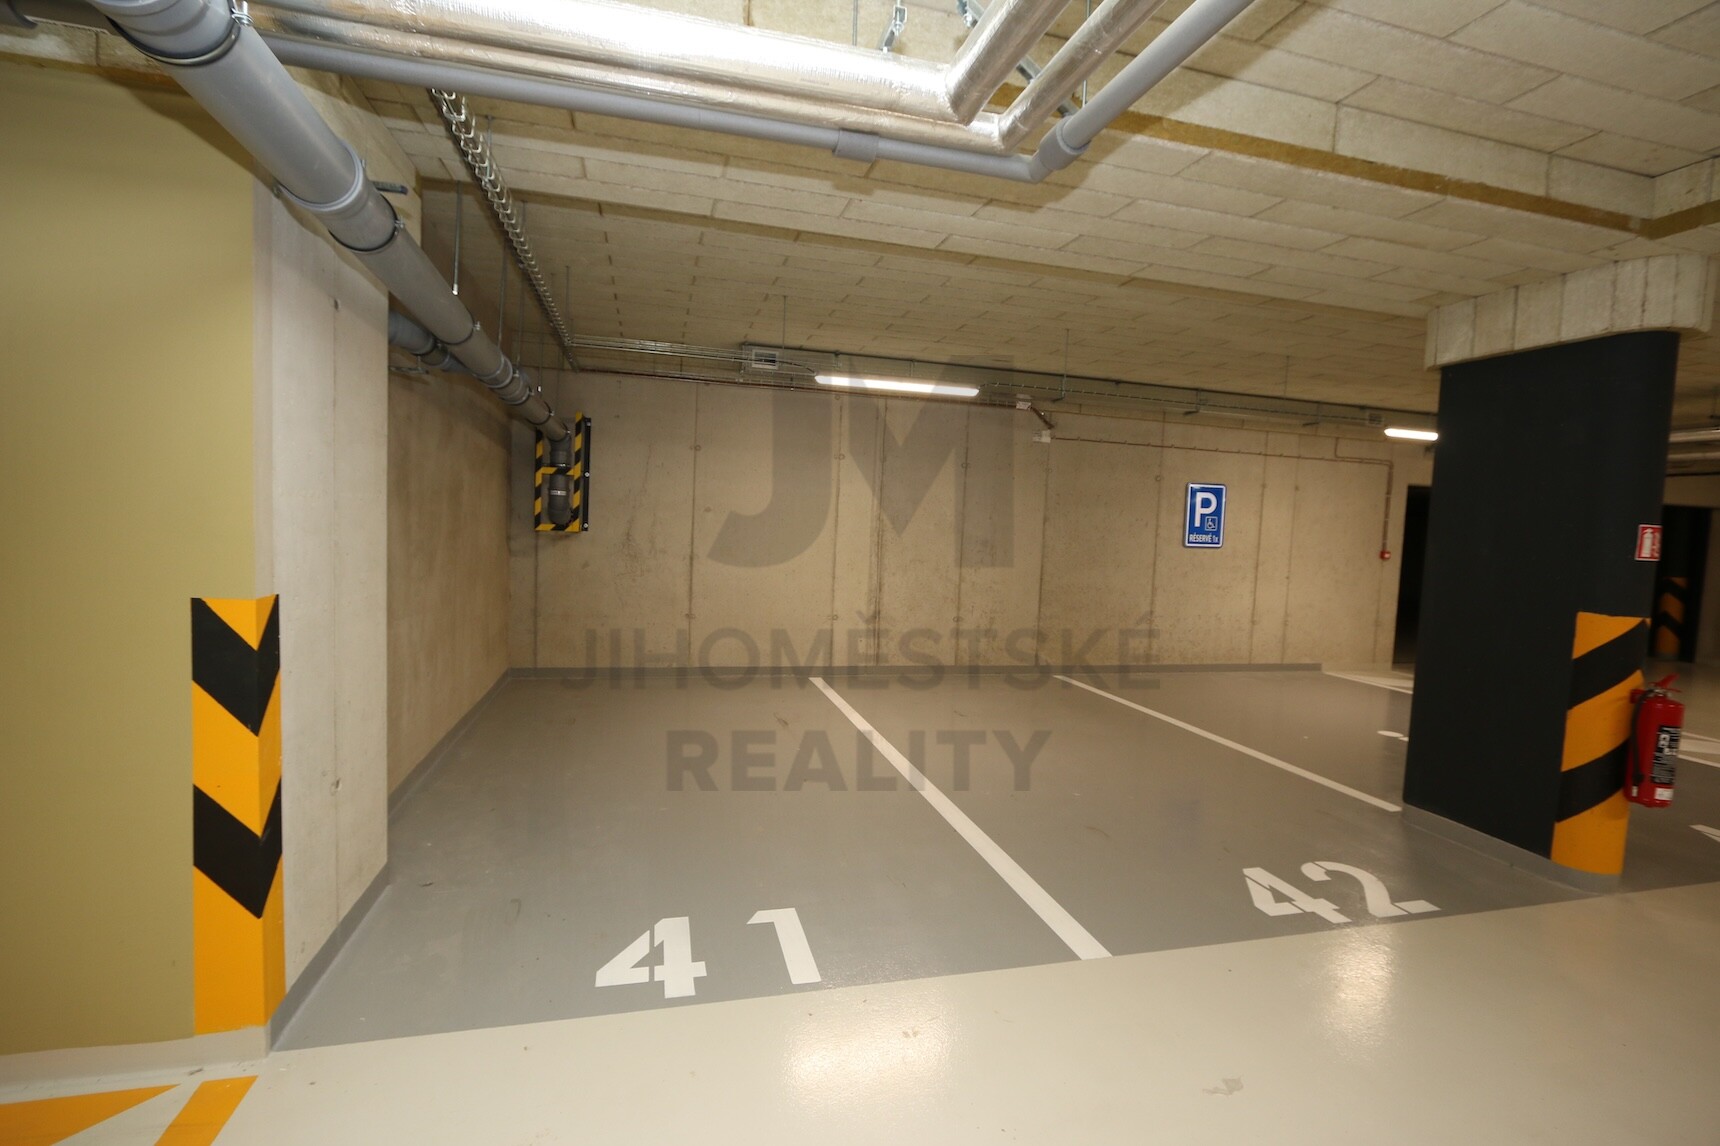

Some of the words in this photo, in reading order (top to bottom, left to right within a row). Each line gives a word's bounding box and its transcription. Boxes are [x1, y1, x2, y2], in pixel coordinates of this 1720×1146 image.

[1194, 491, 1218, 527] P
[1242, 860, 1442, 924] 42
[595, 907, 822, 999] 41
